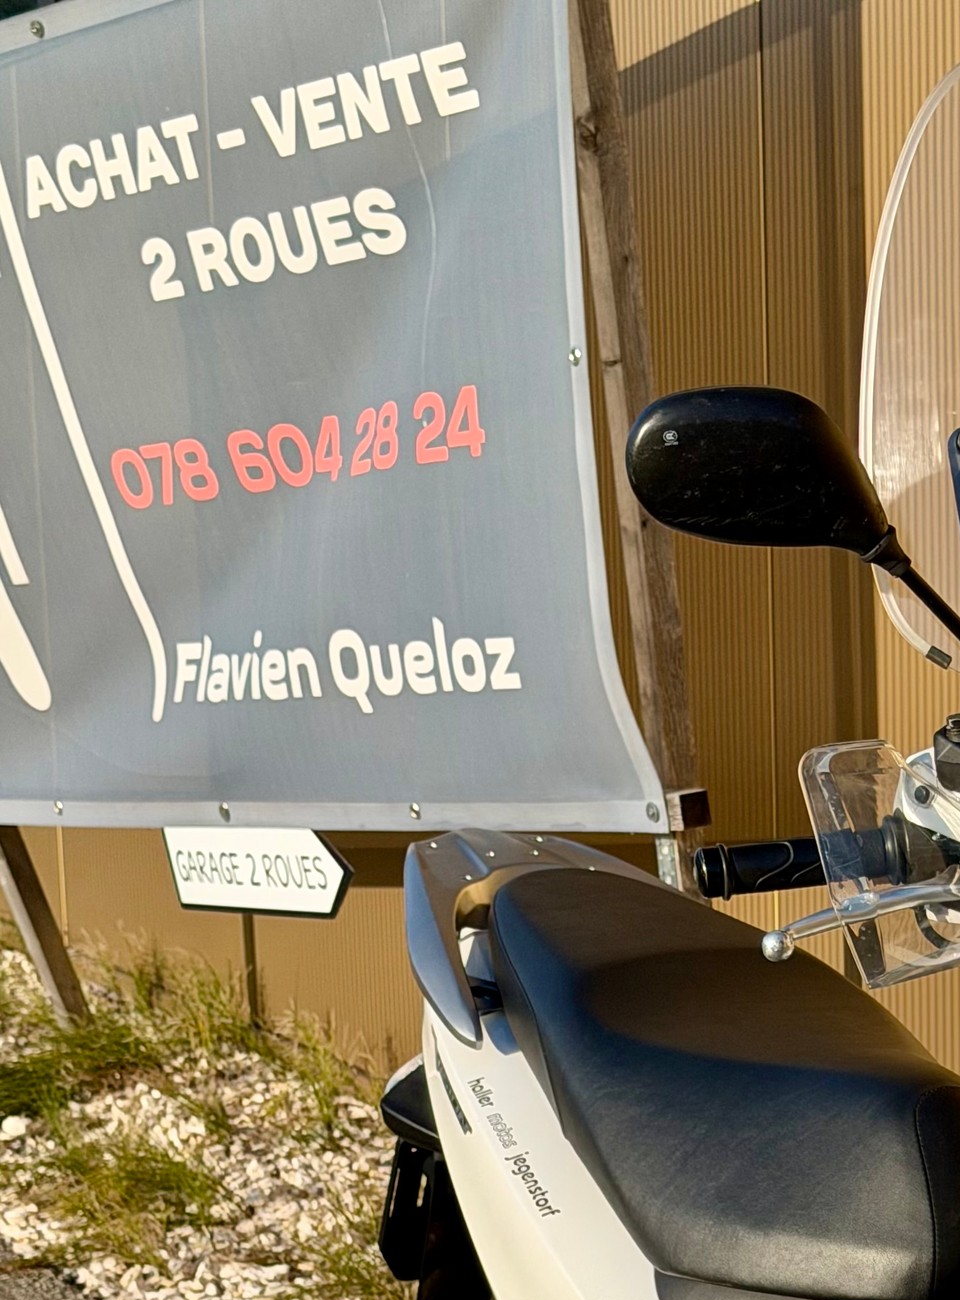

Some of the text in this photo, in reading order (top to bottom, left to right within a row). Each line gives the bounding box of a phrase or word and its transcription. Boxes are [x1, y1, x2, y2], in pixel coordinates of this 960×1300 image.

[26, 114, 198, 218] ACHAT
[251, 42, 479, 157] VENTE
[142, 188, 406, 301] 2 ROUES
[111, 384, 485, 508] 078 604 28 24
[173, 616, 522, 713] Flavien Queloz
[175, 850, 328, 890] GARAGE 2 ROUES
[467, 1077, 494, 1108] haller
[504, 1151, 561, 1218] jegenstorf
